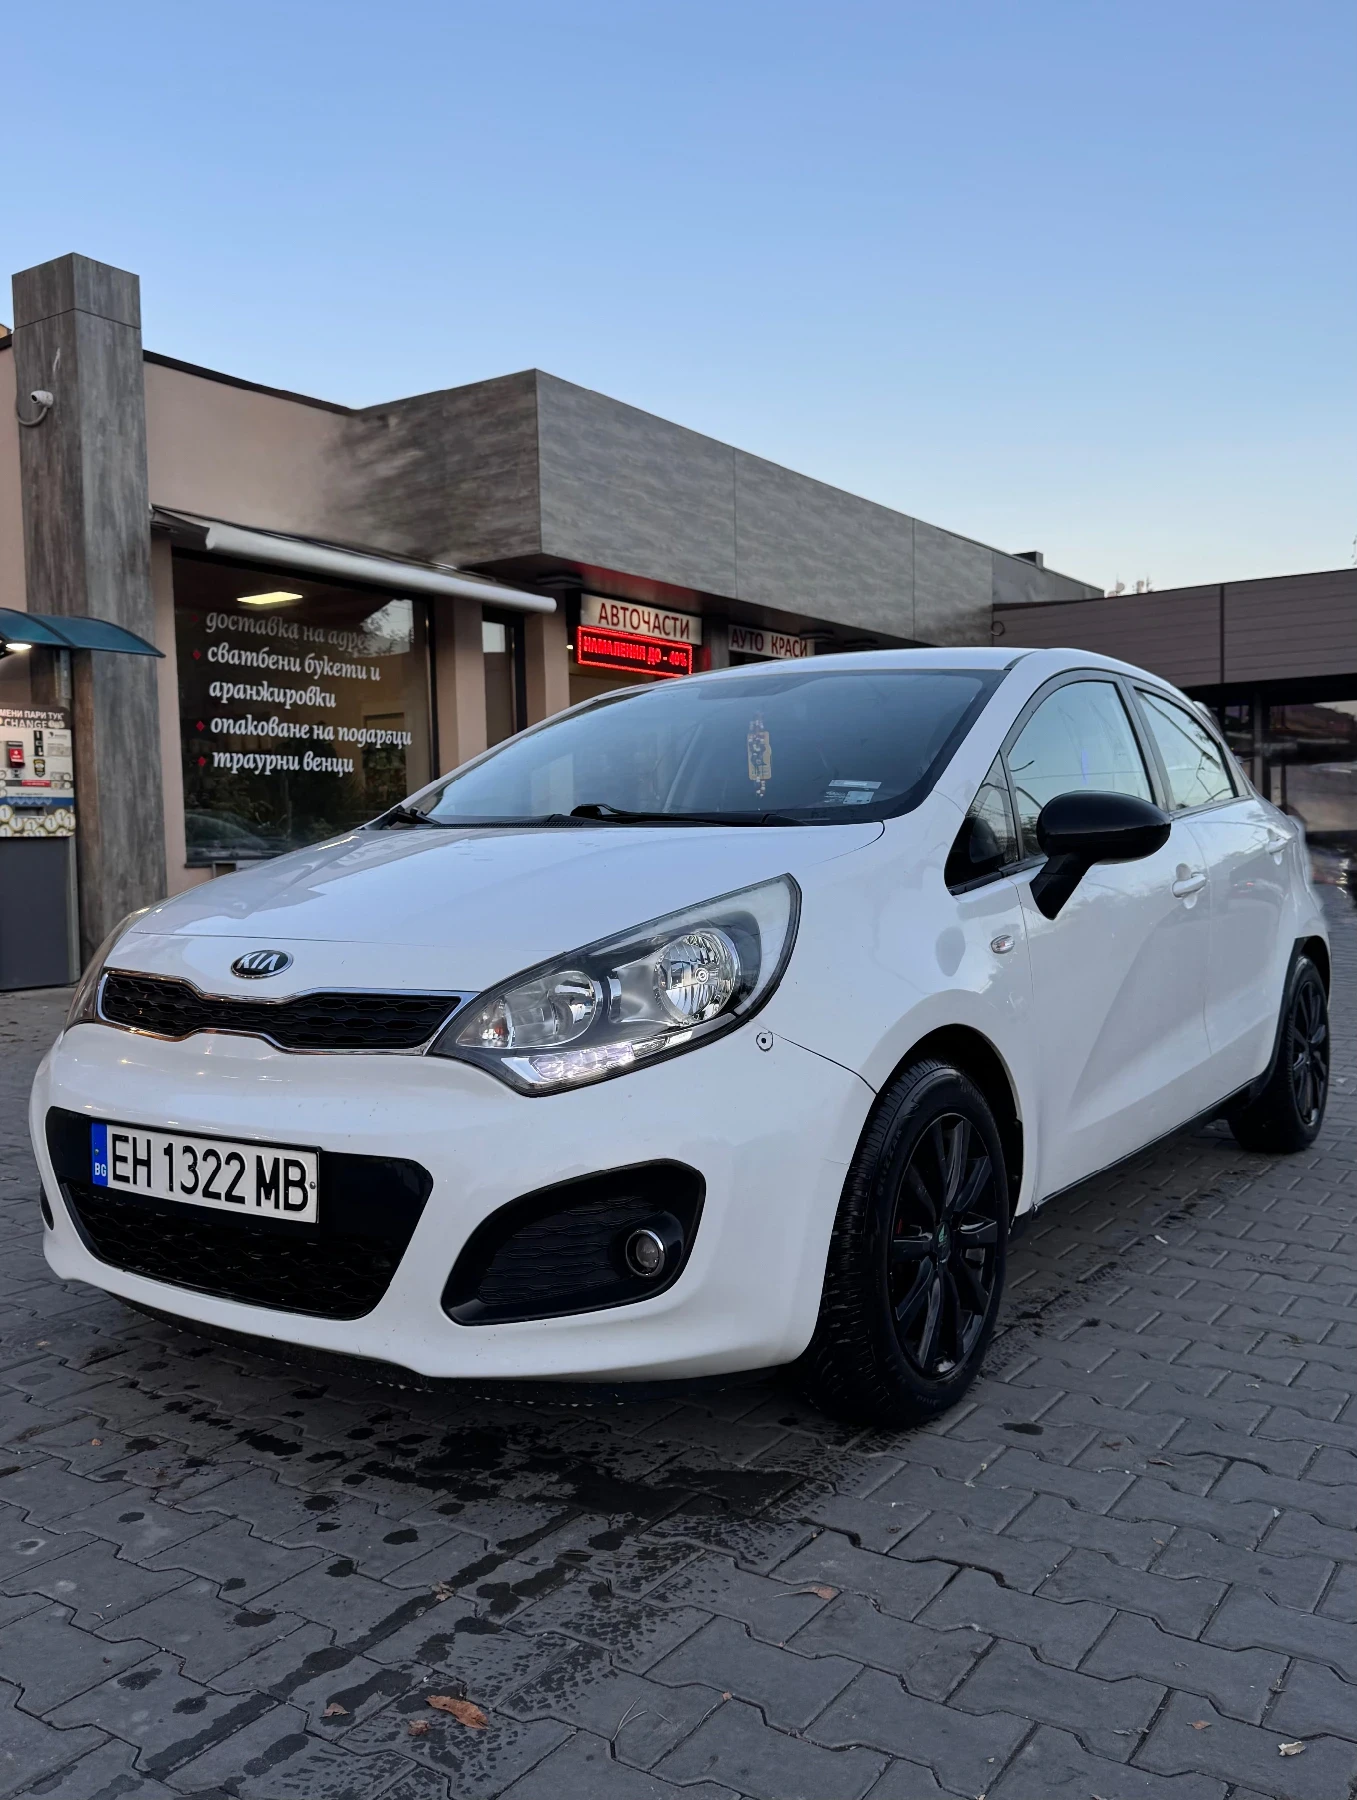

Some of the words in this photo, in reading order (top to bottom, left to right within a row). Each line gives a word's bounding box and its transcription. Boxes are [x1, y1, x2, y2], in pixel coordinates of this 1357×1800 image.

[206, 611, 300, 640] доставка
[303, 626, 325, 642] на
[327, 629, 371, 651] адре
[598, 602, 690, 640] АВТОЧАСТИ
[583, 636, 646, 661] НАМАЛЕНИЯ
[647, 646, 662, 666] ДО
[731, 628, 764, 651] АУТО
[771, 635, 808, 658] КРАСИ
[207, 642, 301, 673] сватбени
[304, 653, 367, 680] букети
[370, 666, 381, 681] и
[209, 680, 336, 709] аранжировки
[4, 718, 48, 729] CHANGE
[24, 710, 47, 720] ПАРИ
[210, 714, 310, 739] опаковане
[312, 724, 335, 741] на
[337, 726, 412, 749] подаръци
[212, 751, 300, 776] траурни
[303, 750, 355, 778] венци
[236, 952, 281, 971] KIA
[94, 1162, 107, 1177] BG
[112, 1133, 152, 1188] EH
[163, 1142, 246, 1204] 1322
[256, 1154, 309, 1212] MB
